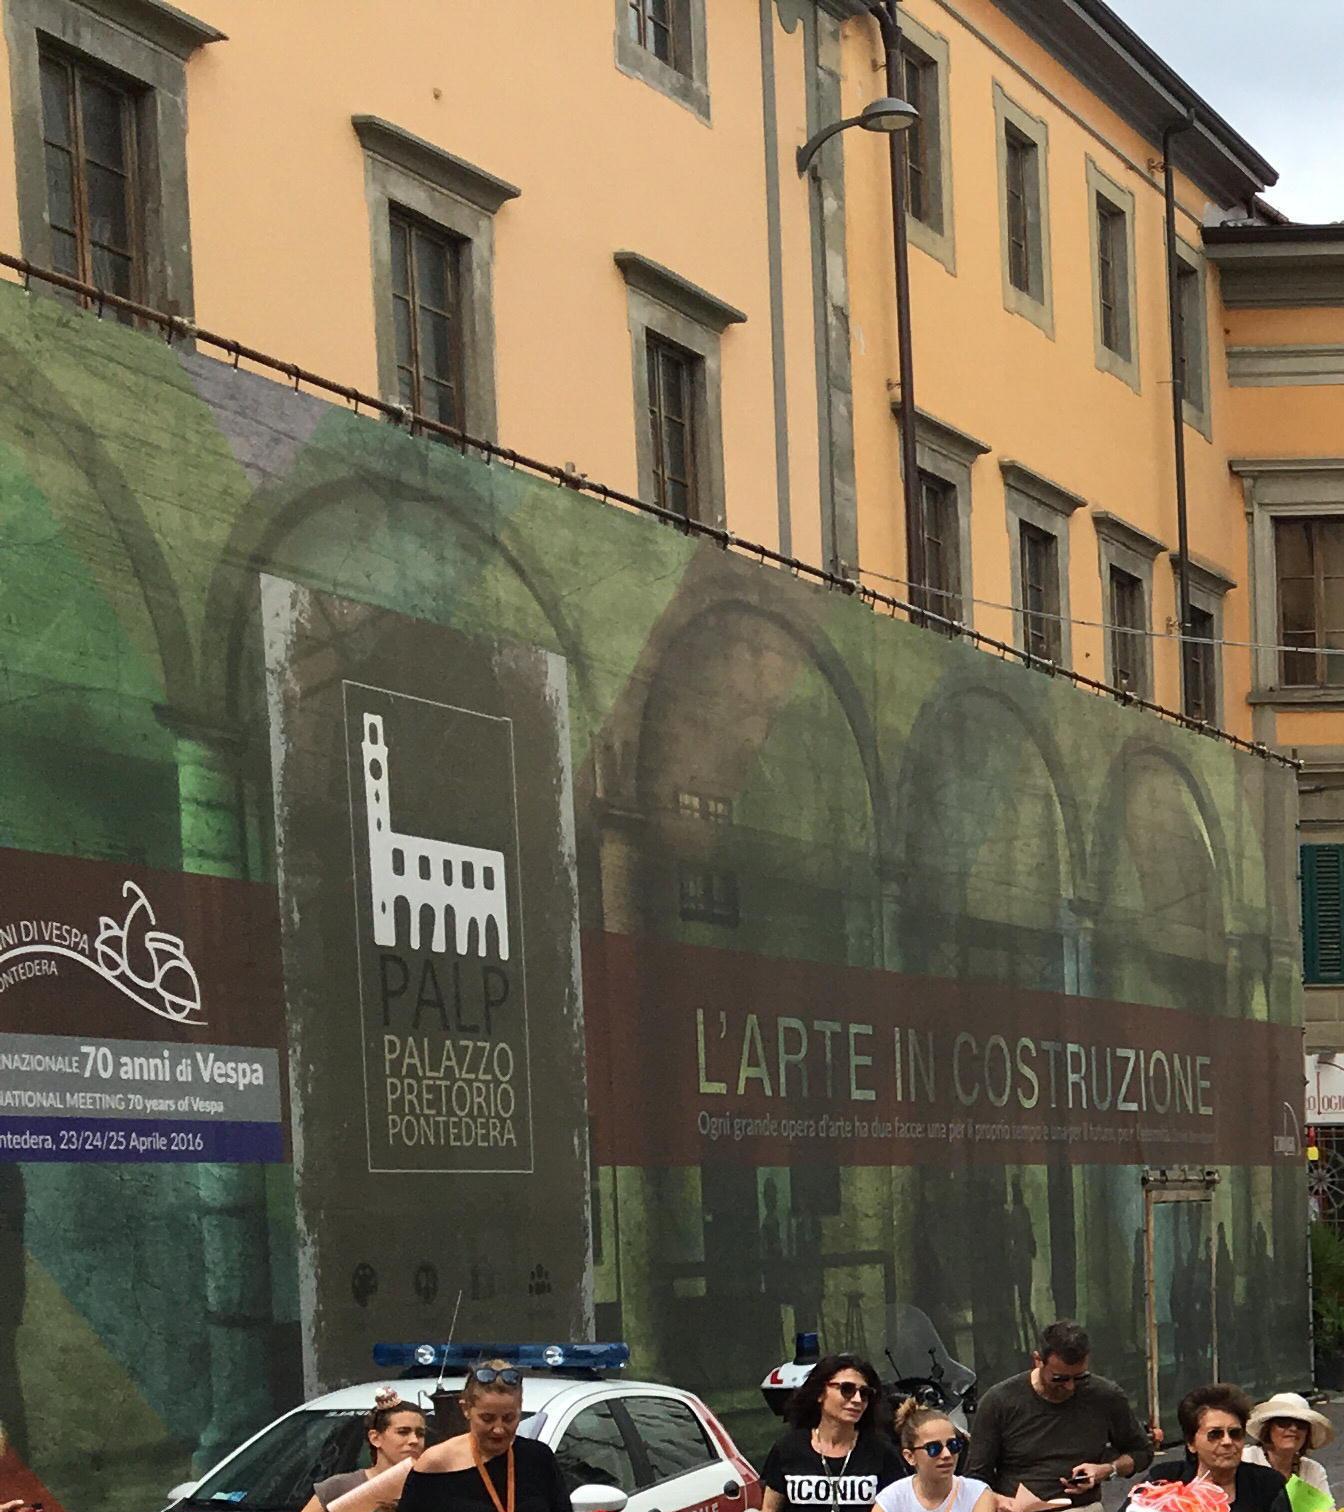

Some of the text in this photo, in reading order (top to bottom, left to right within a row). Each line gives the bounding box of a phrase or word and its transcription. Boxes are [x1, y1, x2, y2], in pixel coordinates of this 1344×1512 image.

[20, 920, 38, 942] DI
[41, 920, 89, 955] VESPA
[380, 953, 511, 1036] PALP
[80, 1046, 113, 1079] 70
[119, 1050, 170, 1082] anni
[176, 1061, 192, 1083] di
[196, 1052, 264, 1091] Vespa
[383, 1034, 514, 1083] PALAZZO
[697, 1008, 1213, 1116] L'ARTE IN COSTRUZIONE
[66, 1091, 125, 1111] MEETING
[128, 1096, 143, 1110] 70
[145, 1097, 176, 1113] years
[178, 1095, 190, 1111] of
[190, 1096, 224, 1115] Vespa
[386, 1077, 515, 1119] PRETORIO
[0, 1130, 204, 1153] ntedera, 23/24/25 Aprile 2016
[388, 1114, 517, 1147] PONTEDERA
[697, 1110, 730, 1141] Ogni
[733, 1113, 778, 1140] grande
[781, 1118, 815, 1141] opera
[789, 1479, 873, 1502] ICONIC
